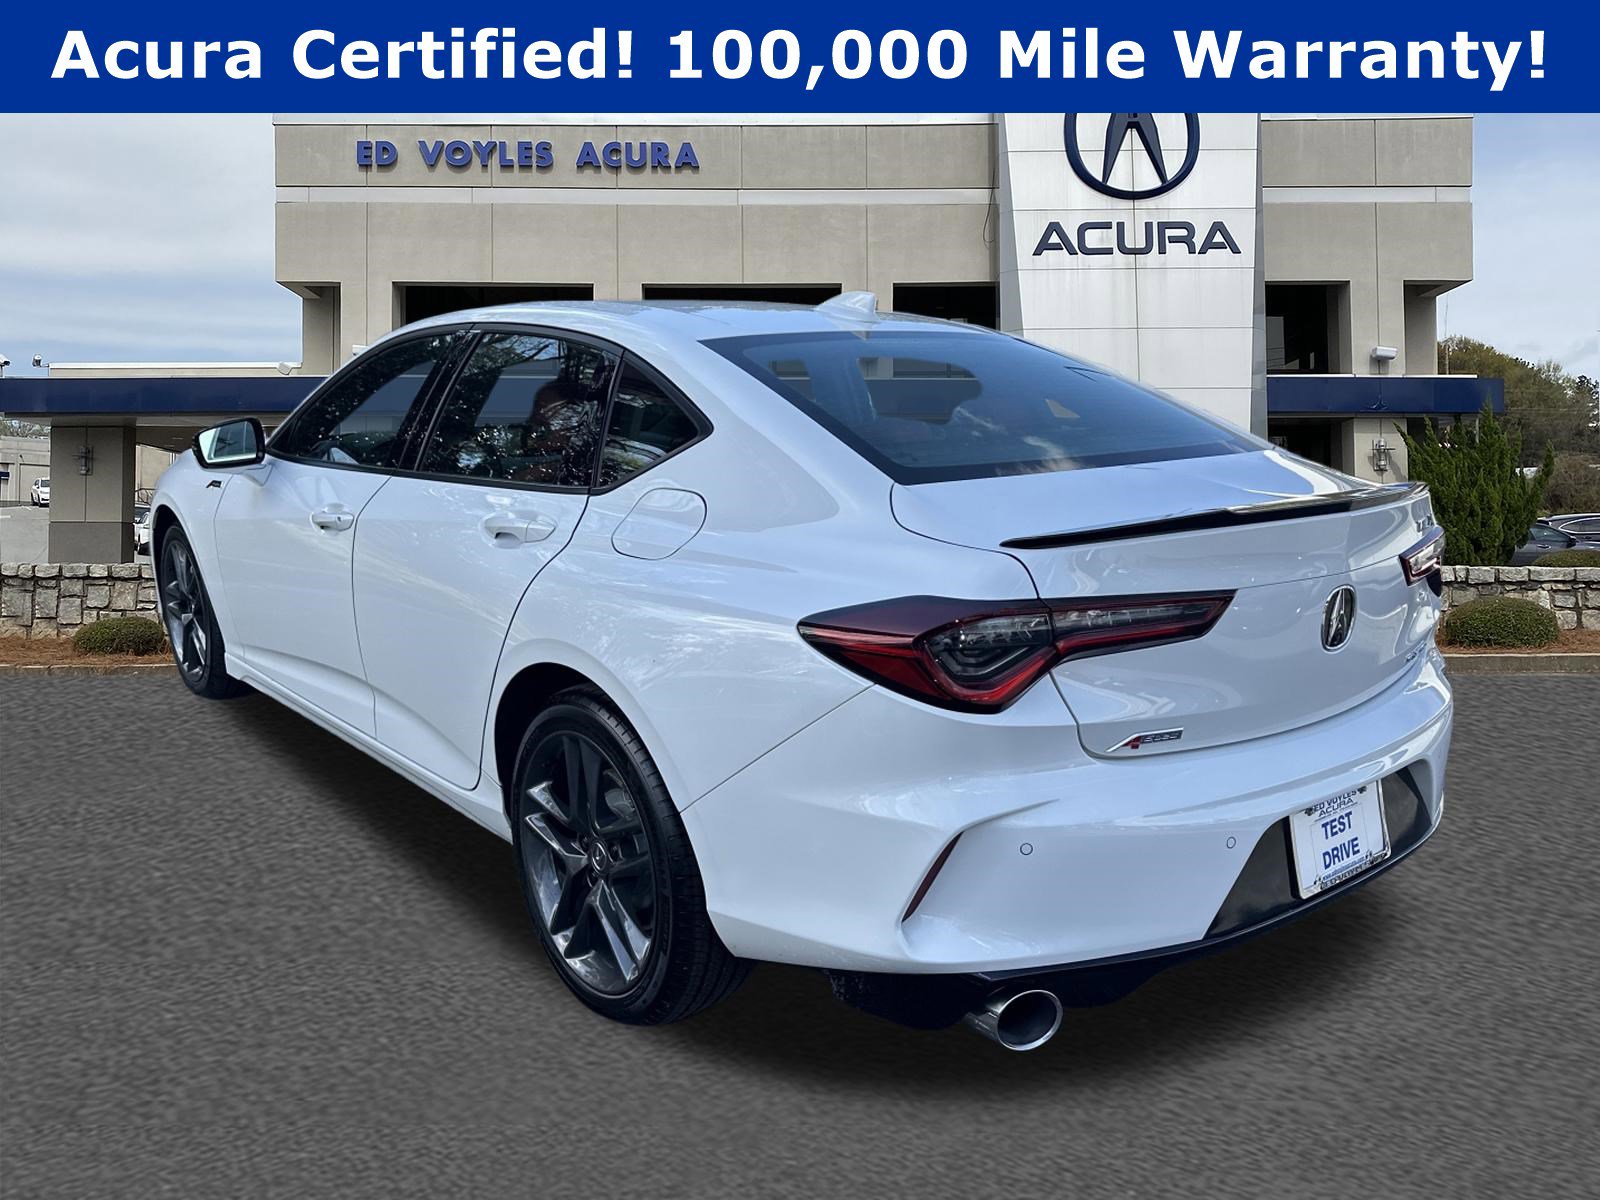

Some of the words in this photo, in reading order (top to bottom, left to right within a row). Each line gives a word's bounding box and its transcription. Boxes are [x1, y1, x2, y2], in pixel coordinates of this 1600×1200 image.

[356, 140, 398, 167] ED
[418, 140, 555, 169] VOYLES
[576, 141, 700, 169] ACURA
[1032, 221, 1242, 256] ACURA
[1313, 801, 1325, 812] ED
[1318, 797, 1354, 817] ACURA
[1321, 811, 1353, 840] TEST
[1322, 837, 1360, 870] DRIVE
